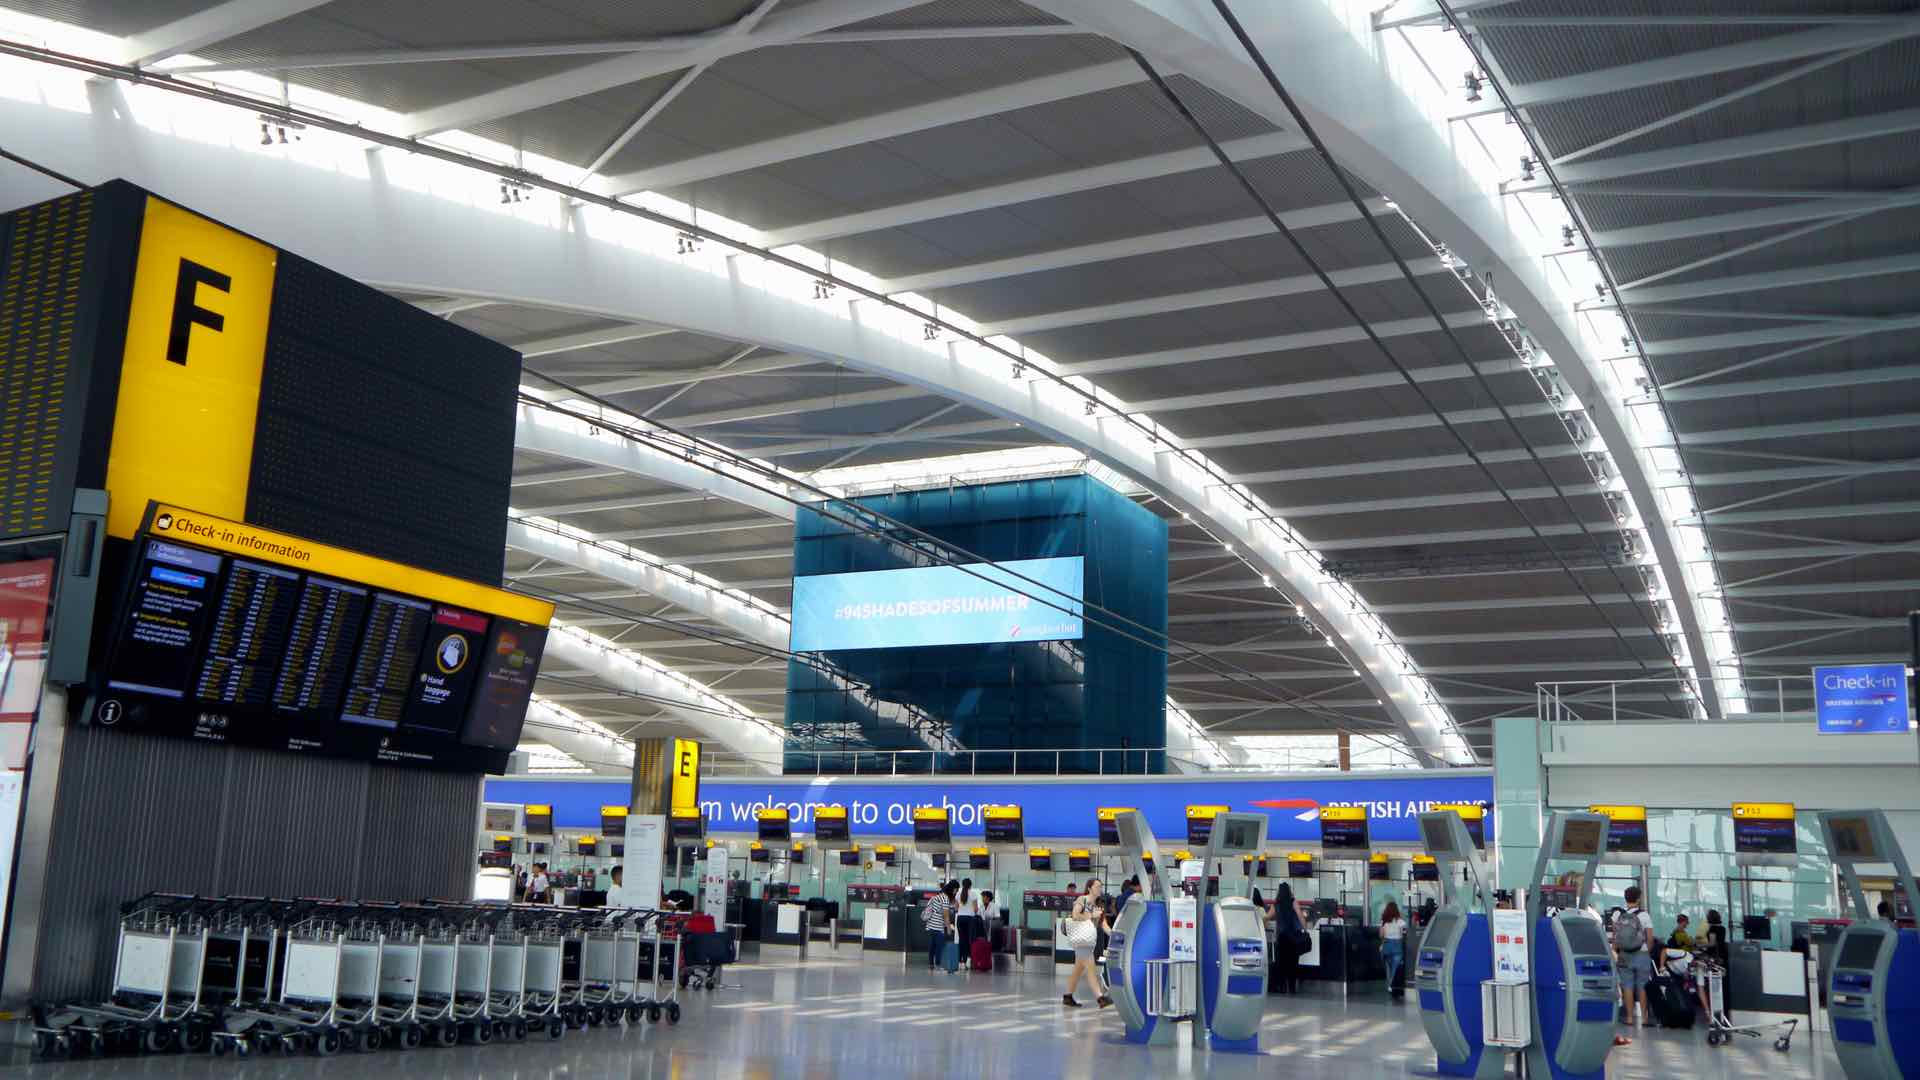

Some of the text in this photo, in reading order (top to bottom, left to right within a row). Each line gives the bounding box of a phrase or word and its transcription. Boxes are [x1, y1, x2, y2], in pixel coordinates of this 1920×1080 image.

[166, 256, 232, 367] F
[176, 518, 311, 561] Check-in information
[1823, 673, 1897, 690] Check-in
[680, 751, 691, 777] E
[852, 800, 878, 824] to
[887, 802, 933, 825] ou
